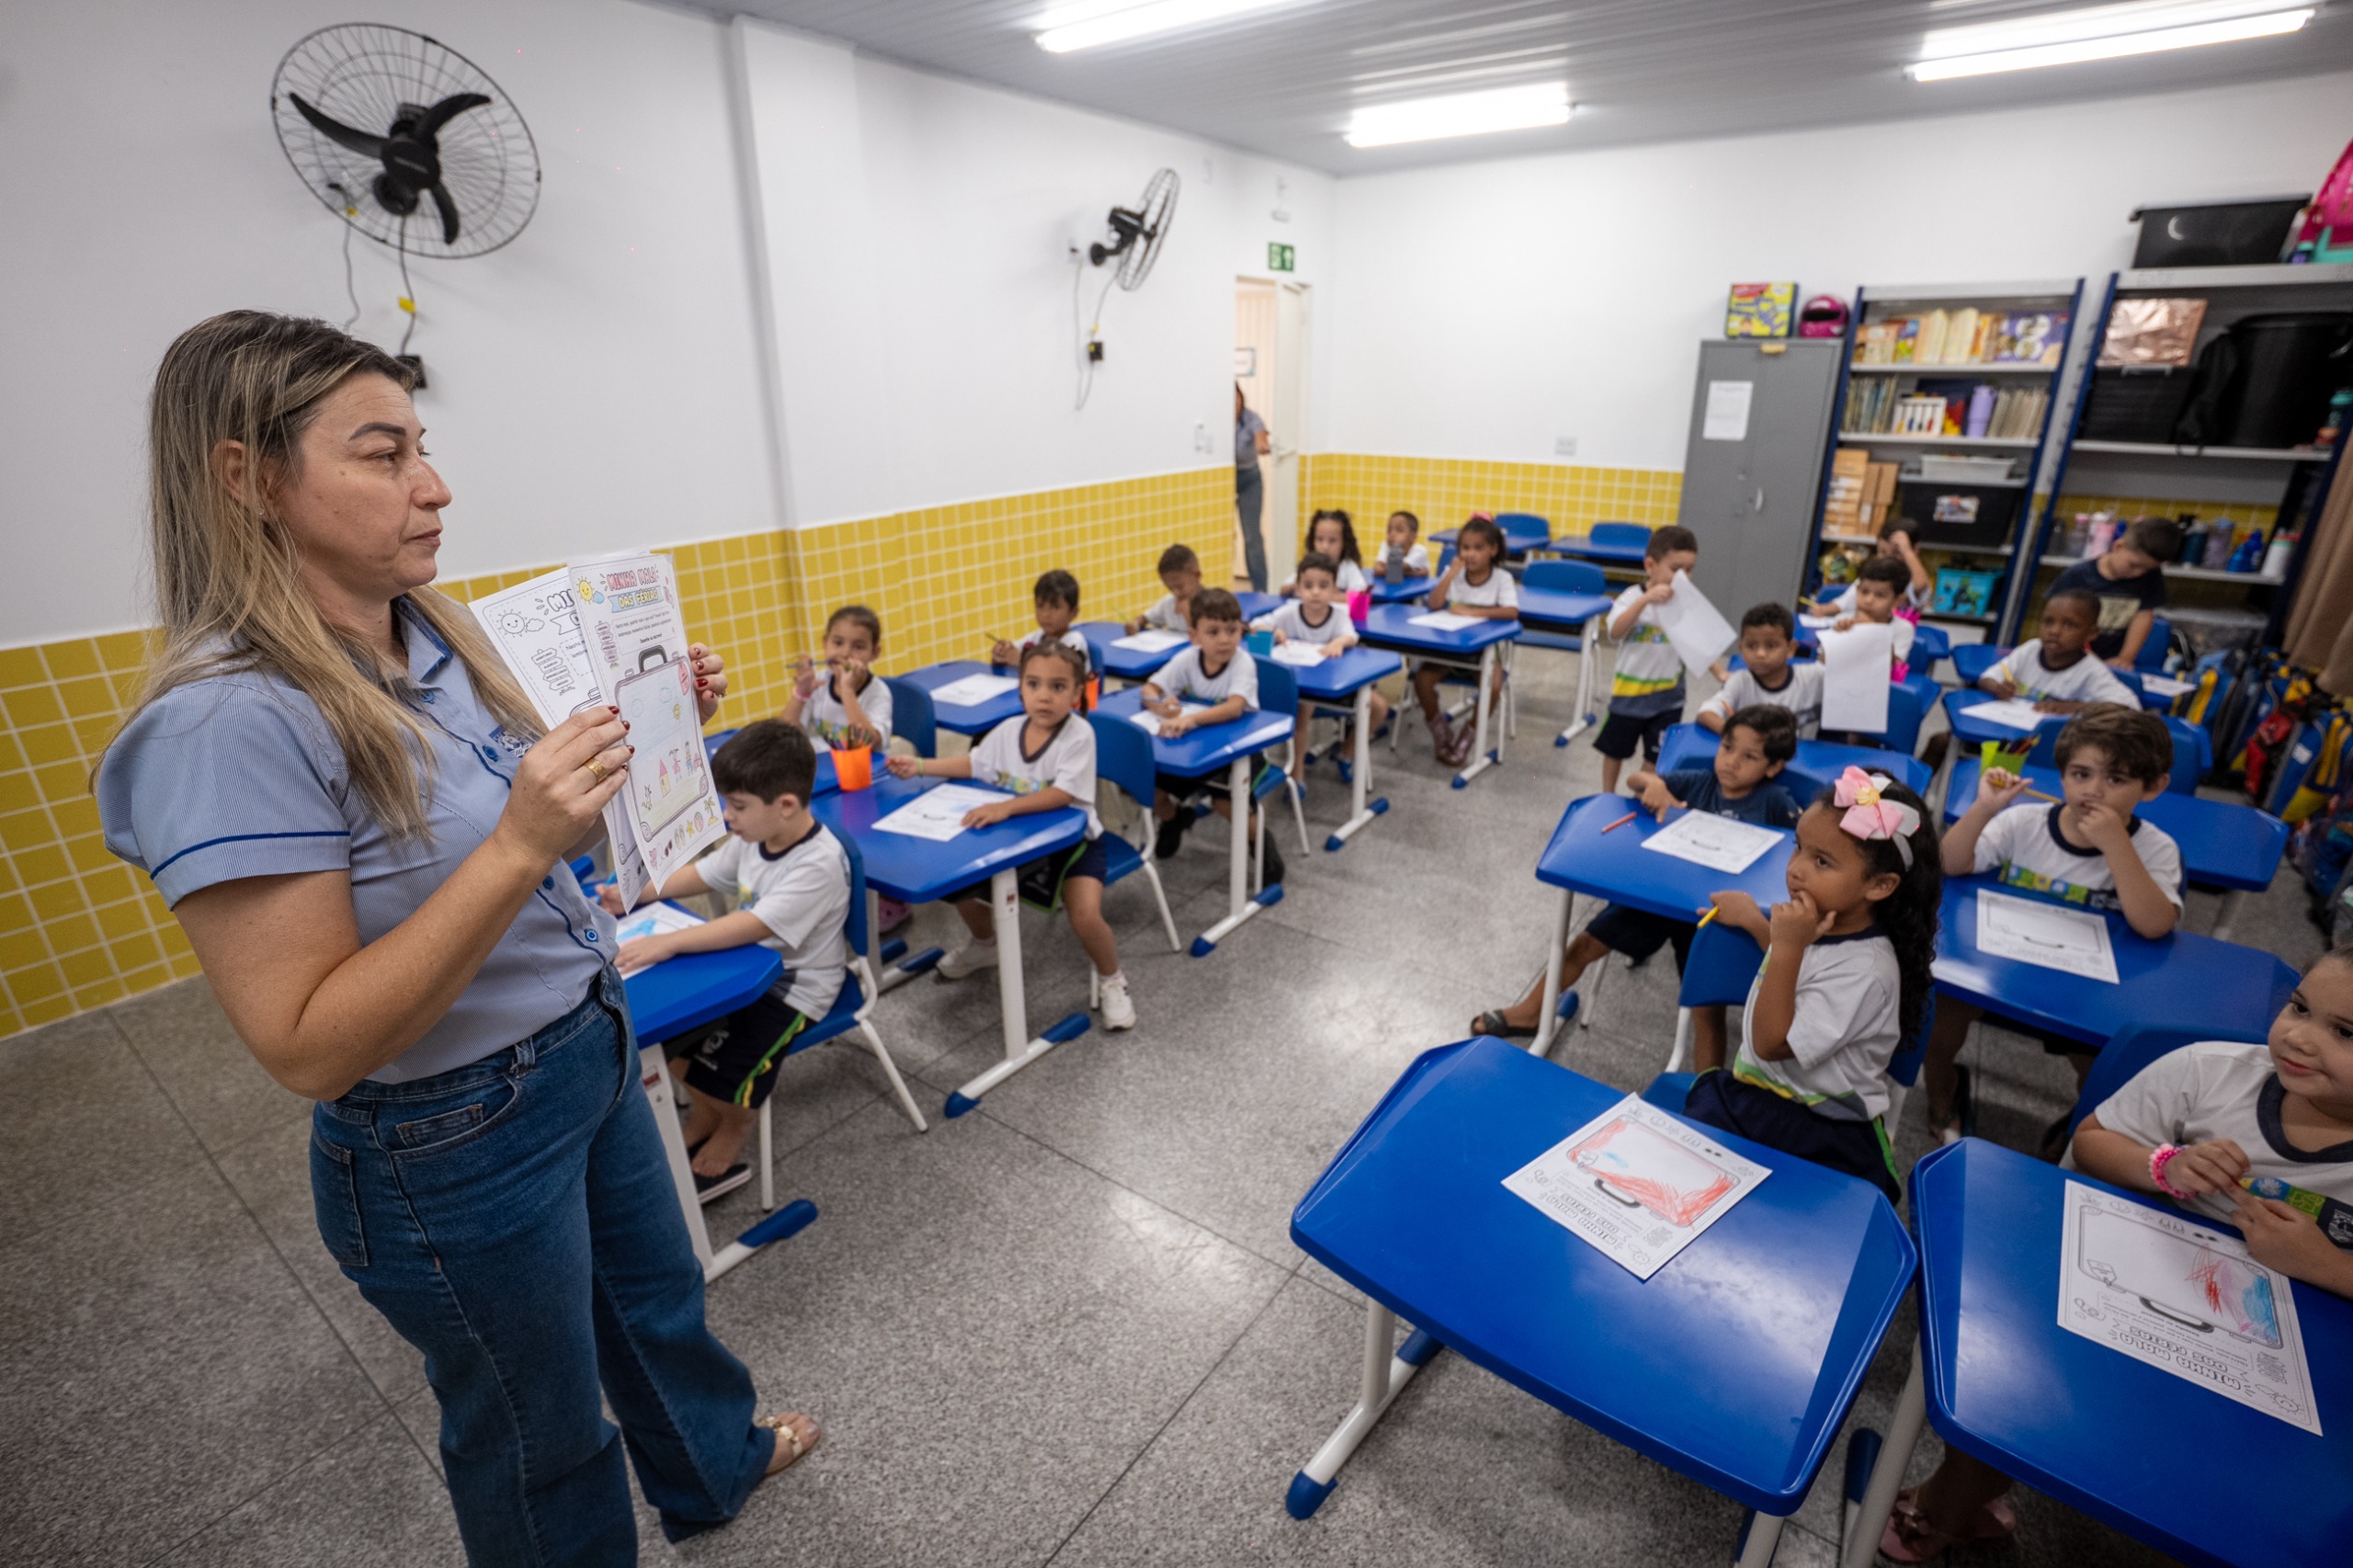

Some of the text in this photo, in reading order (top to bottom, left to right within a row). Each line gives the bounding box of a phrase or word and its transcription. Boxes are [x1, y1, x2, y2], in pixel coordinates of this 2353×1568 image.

[607, 566, 658, 591] MINHA MALA
[618, 588, 658, 608] DAS FÉRIAS
[1577, 1216, 1618, 1245] MINHA
[2120, 1332, 2171, 1361] MALA
[2130, 1325, 2228, 1372] DAS FÉRIAS
[2177, 1356, 2241, 1391] MINHA
